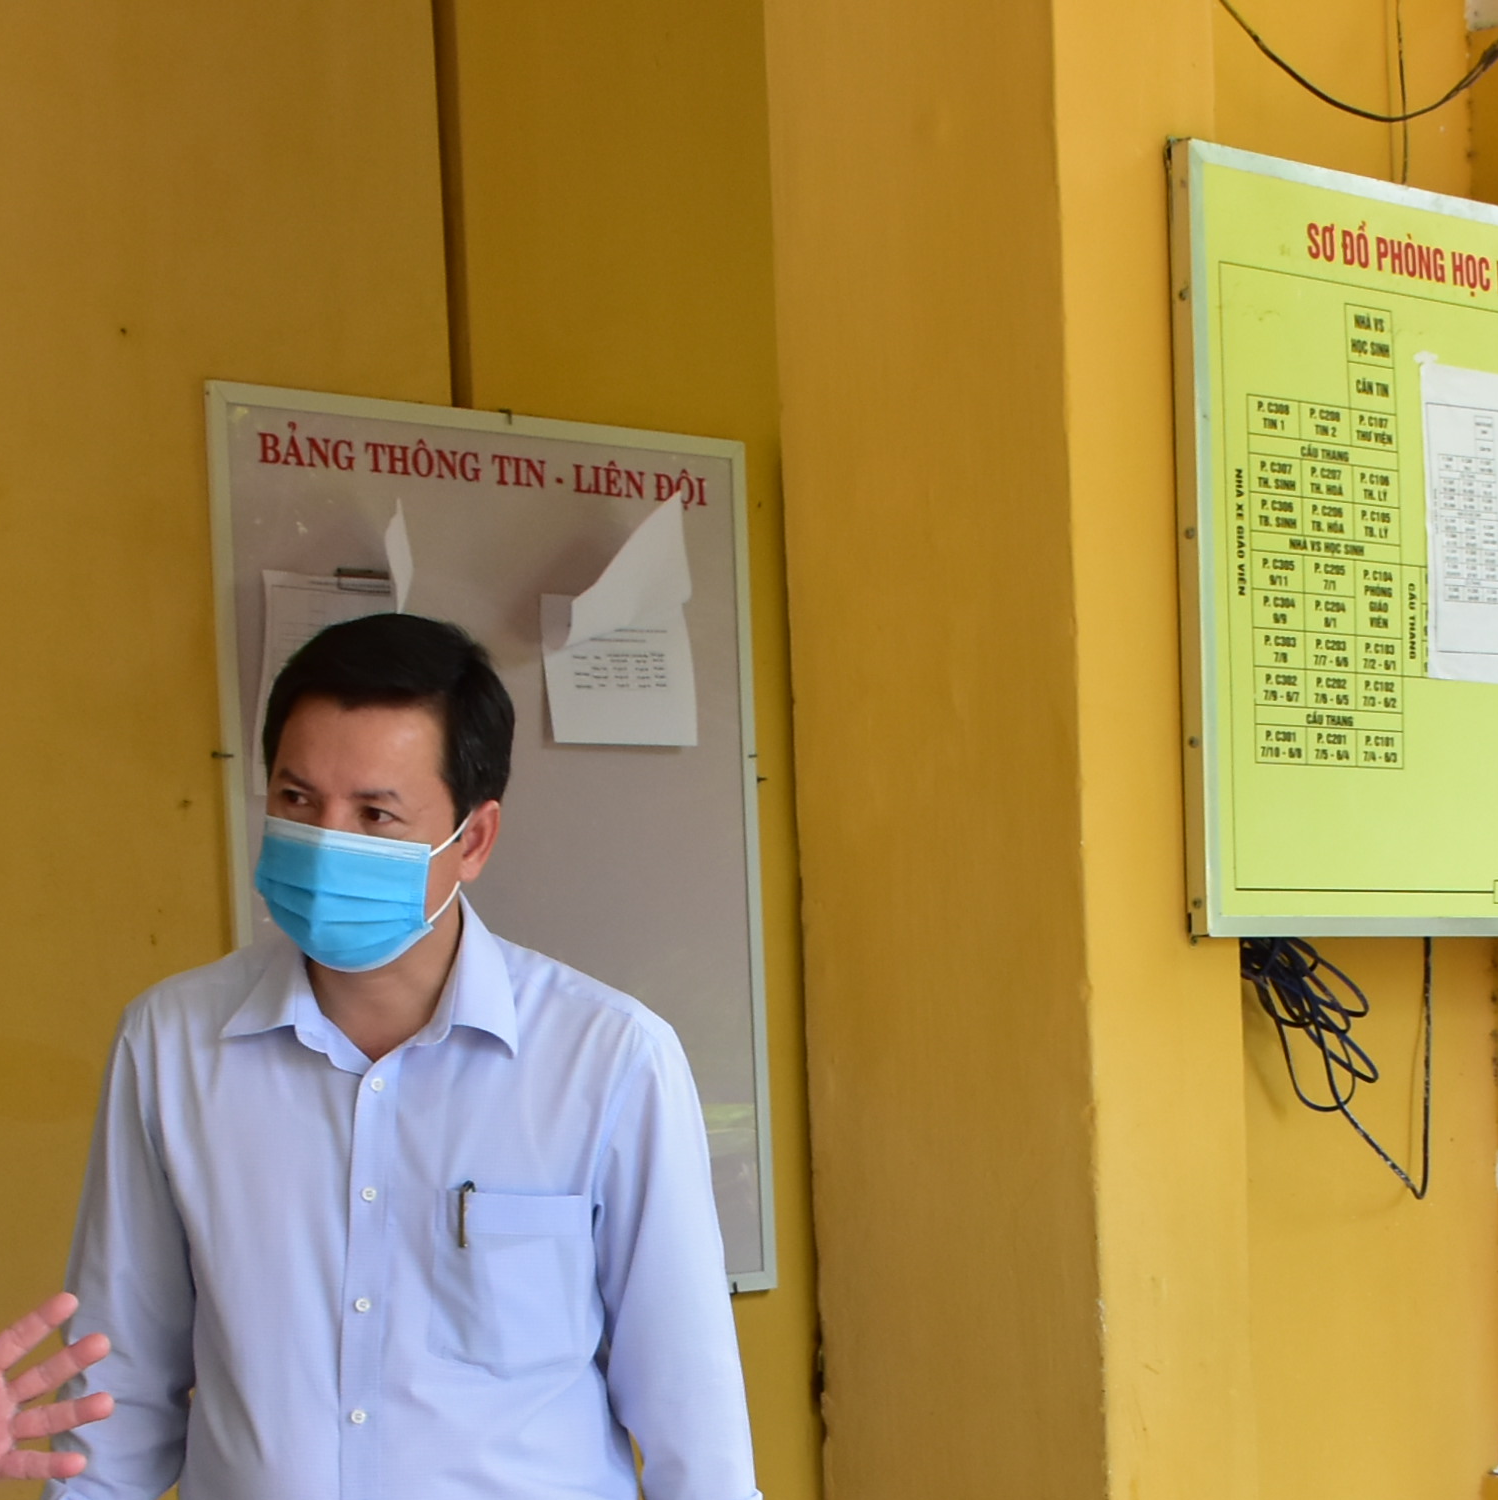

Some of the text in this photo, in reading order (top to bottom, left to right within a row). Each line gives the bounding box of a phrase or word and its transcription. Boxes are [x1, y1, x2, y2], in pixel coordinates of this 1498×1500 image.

[1307, 222, 1336, 263] SƠ
[1376, 233, 1445, 283] PHÒNG
[1452, 252, 1491, 298] HỌC
[258, 421, 355, 471] BẢNG
[365, 439, 482, 483] THÔNG
[491, 454, 545, 488] TIN
[574, 460, 645, 499] LIÊN
[654, 469, 708, 511] ĐỘI
